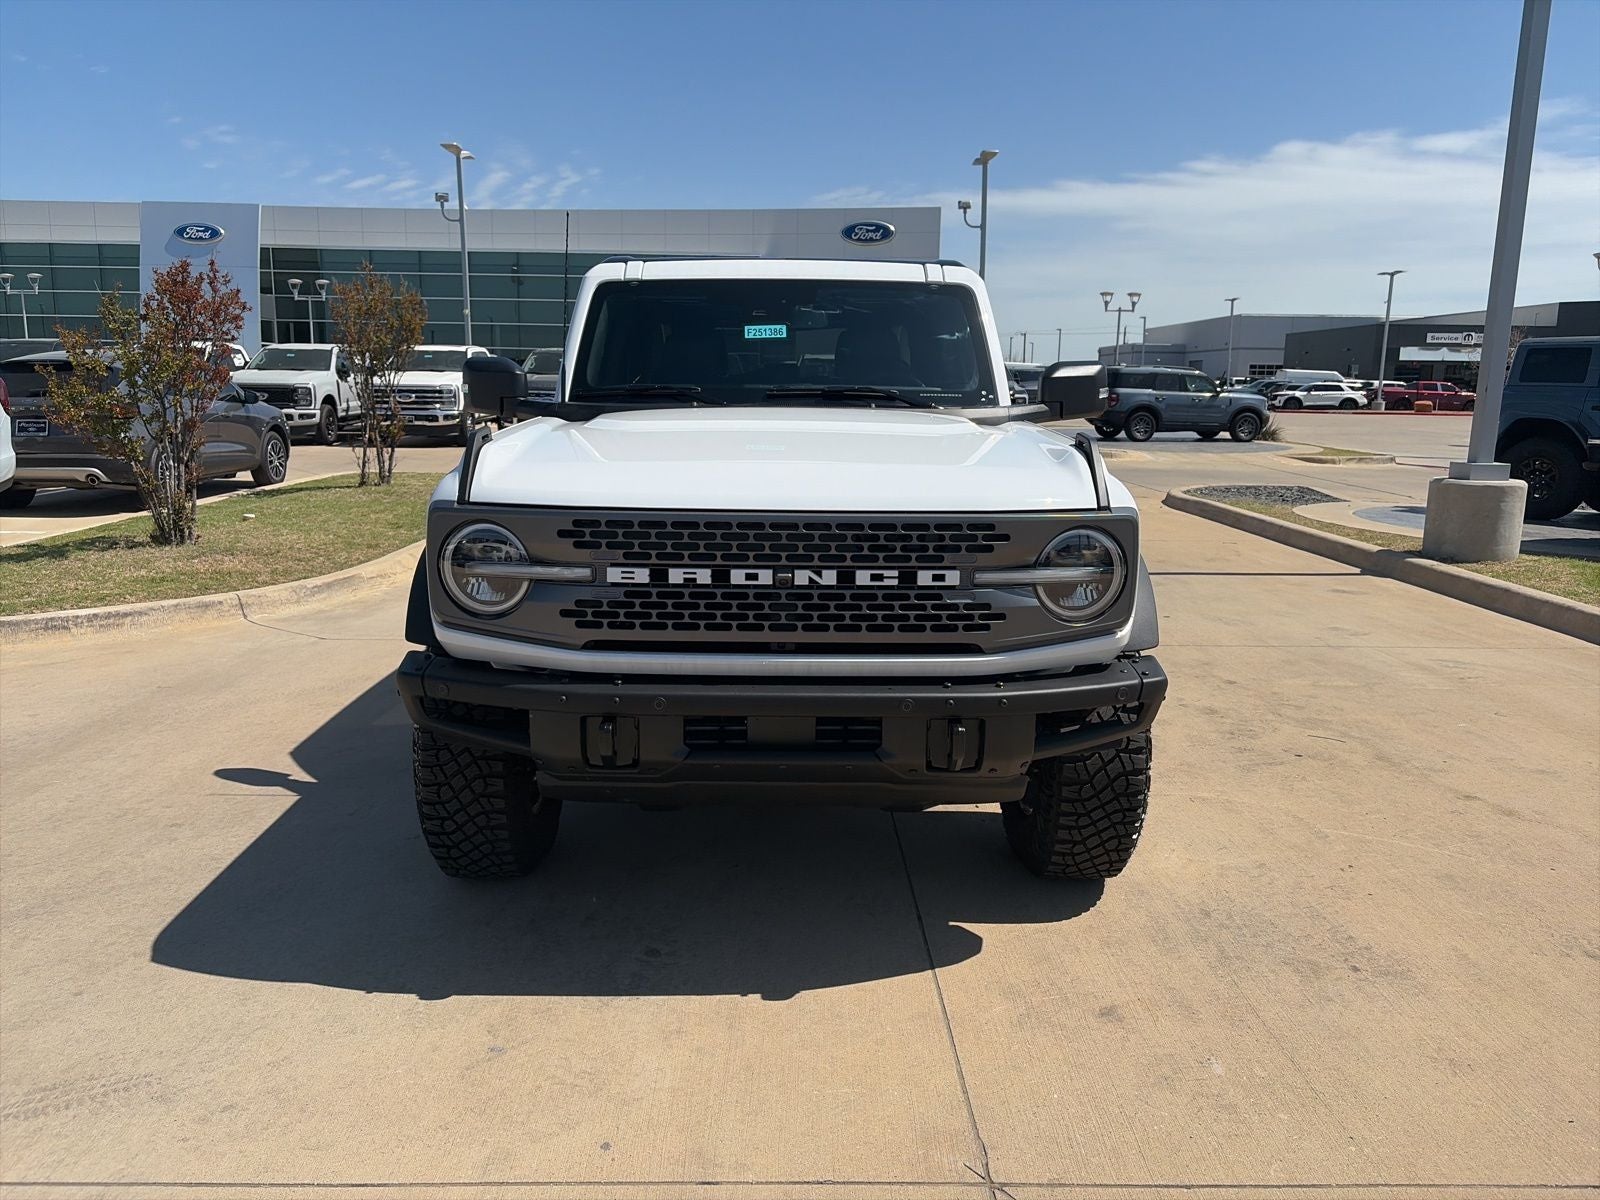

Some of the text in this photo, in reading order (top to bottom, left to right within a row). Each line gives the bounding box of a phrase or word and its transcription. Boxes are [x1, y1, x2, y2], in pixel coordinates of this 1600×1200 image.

[183, 226, 211, 239] Ford
[851, 225, 883, 240] Ford
[747, 327, 784, 337] F251386
[606, 566, 961, 586] BRONCO
